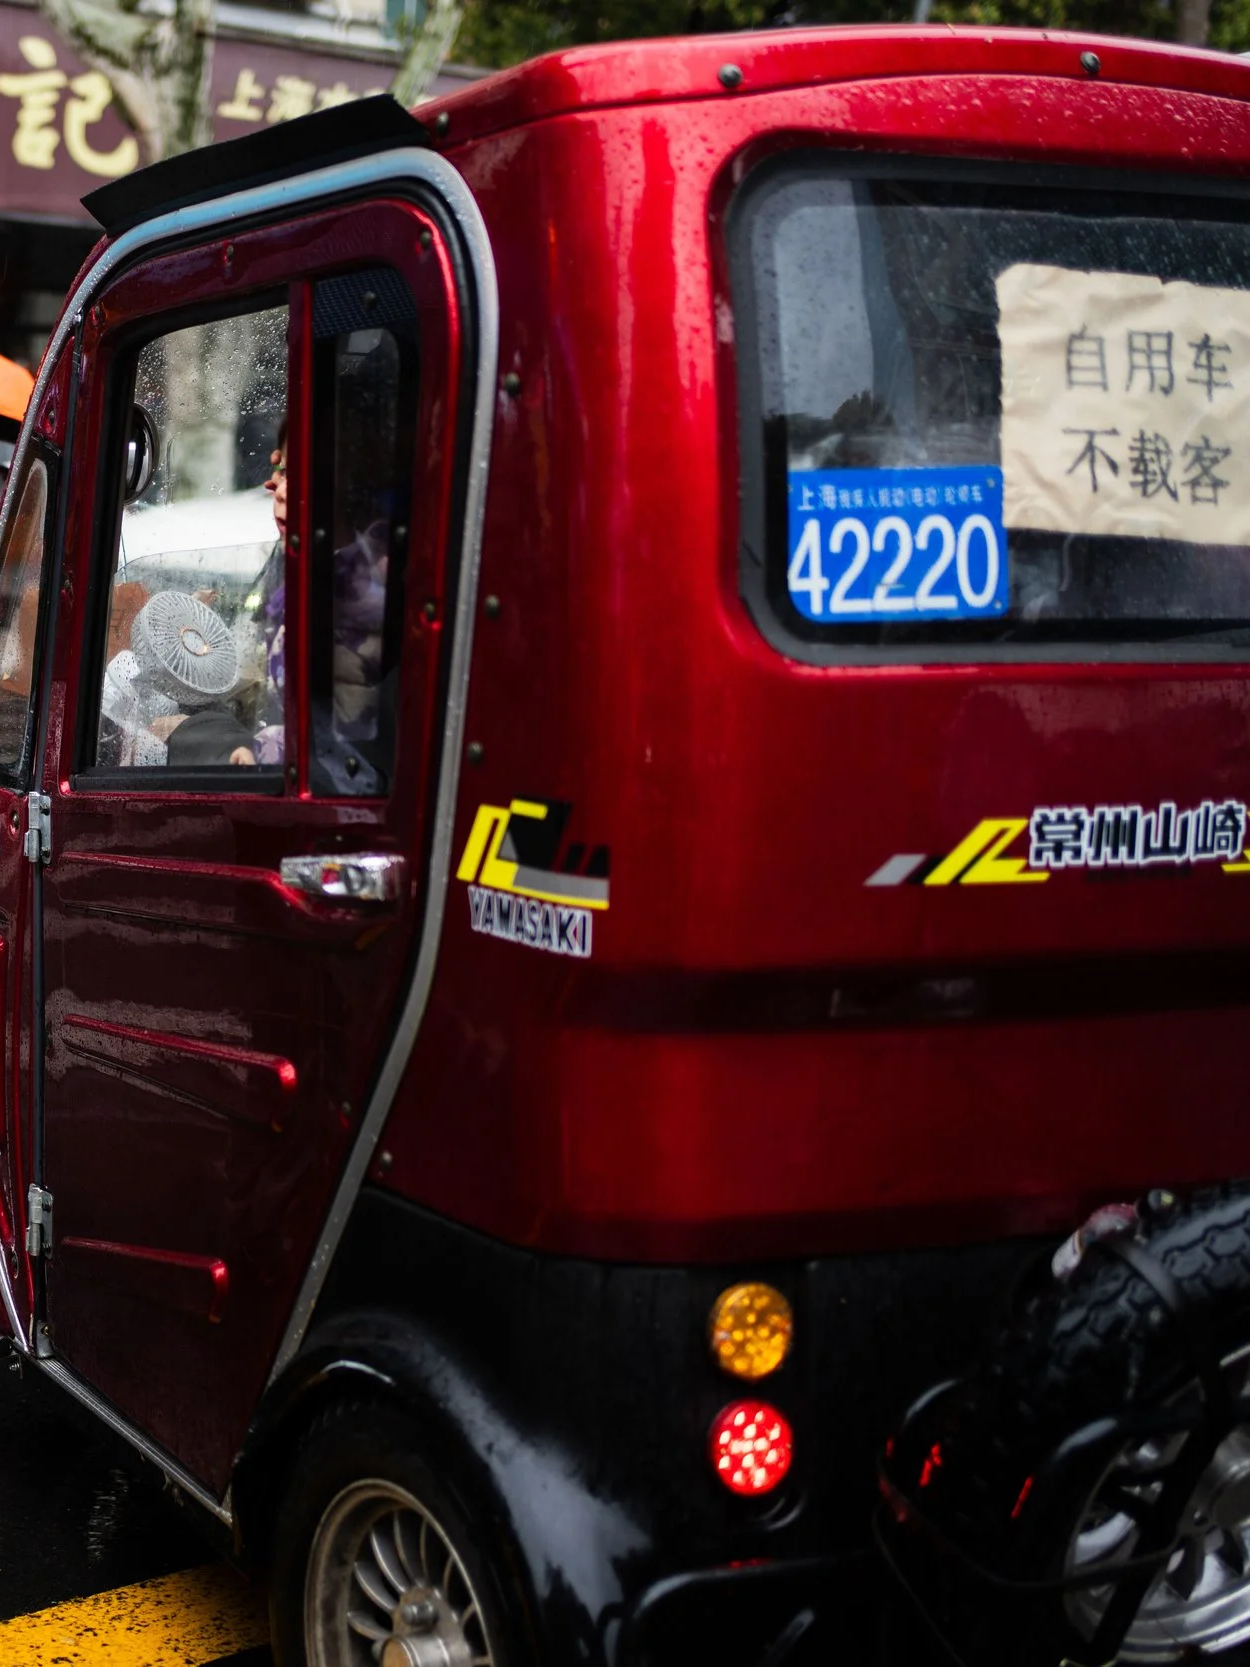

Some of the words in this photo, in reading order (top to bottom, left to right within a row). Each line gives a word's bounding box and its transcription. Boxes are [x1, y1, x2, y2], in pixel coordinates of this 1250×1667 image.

[216, 67, 387, 124] 上海
[1065, 323, 1235, 402] 自用车
[1061, 427, 1233, 506] 不载客
[787, 514, 1000, 616] 42220
[1030, 800, 1247, 867] 常州山崎
[468, 885, 593, 958] YAMASAKI
